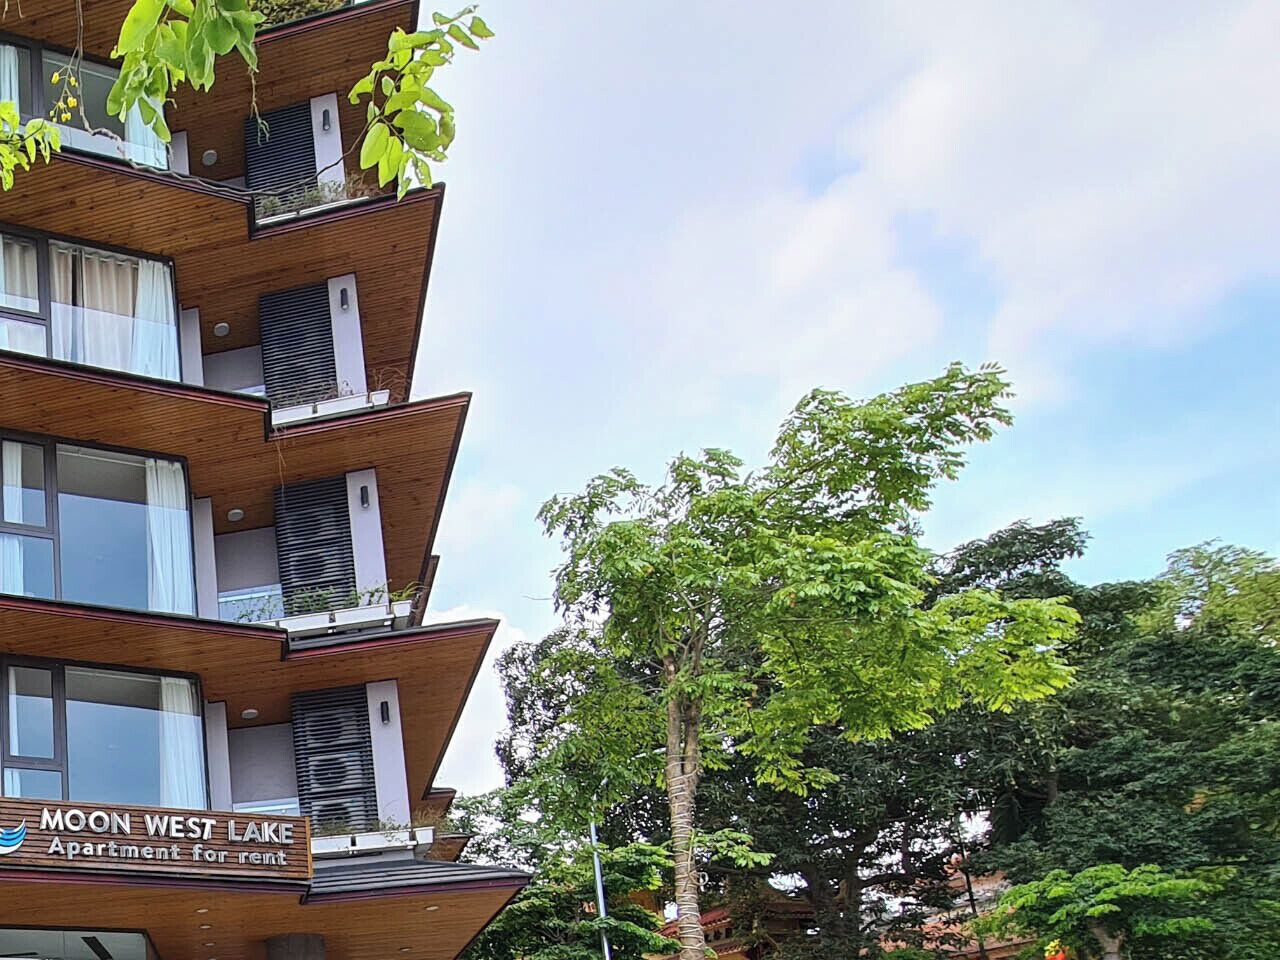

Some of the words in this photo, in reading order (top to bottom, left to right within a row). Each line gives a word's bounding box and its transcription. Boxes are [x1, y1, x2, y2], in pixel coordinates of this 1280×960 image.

[39, 807, 131, 836] MOON
[144, 813, 217, 841] WEST
[228, 819, 294, 845] LAKE
[48, 836, 180, 861] Apartment
[192, 843, 226, 863] for
[238, 849, 288, 867] rent
